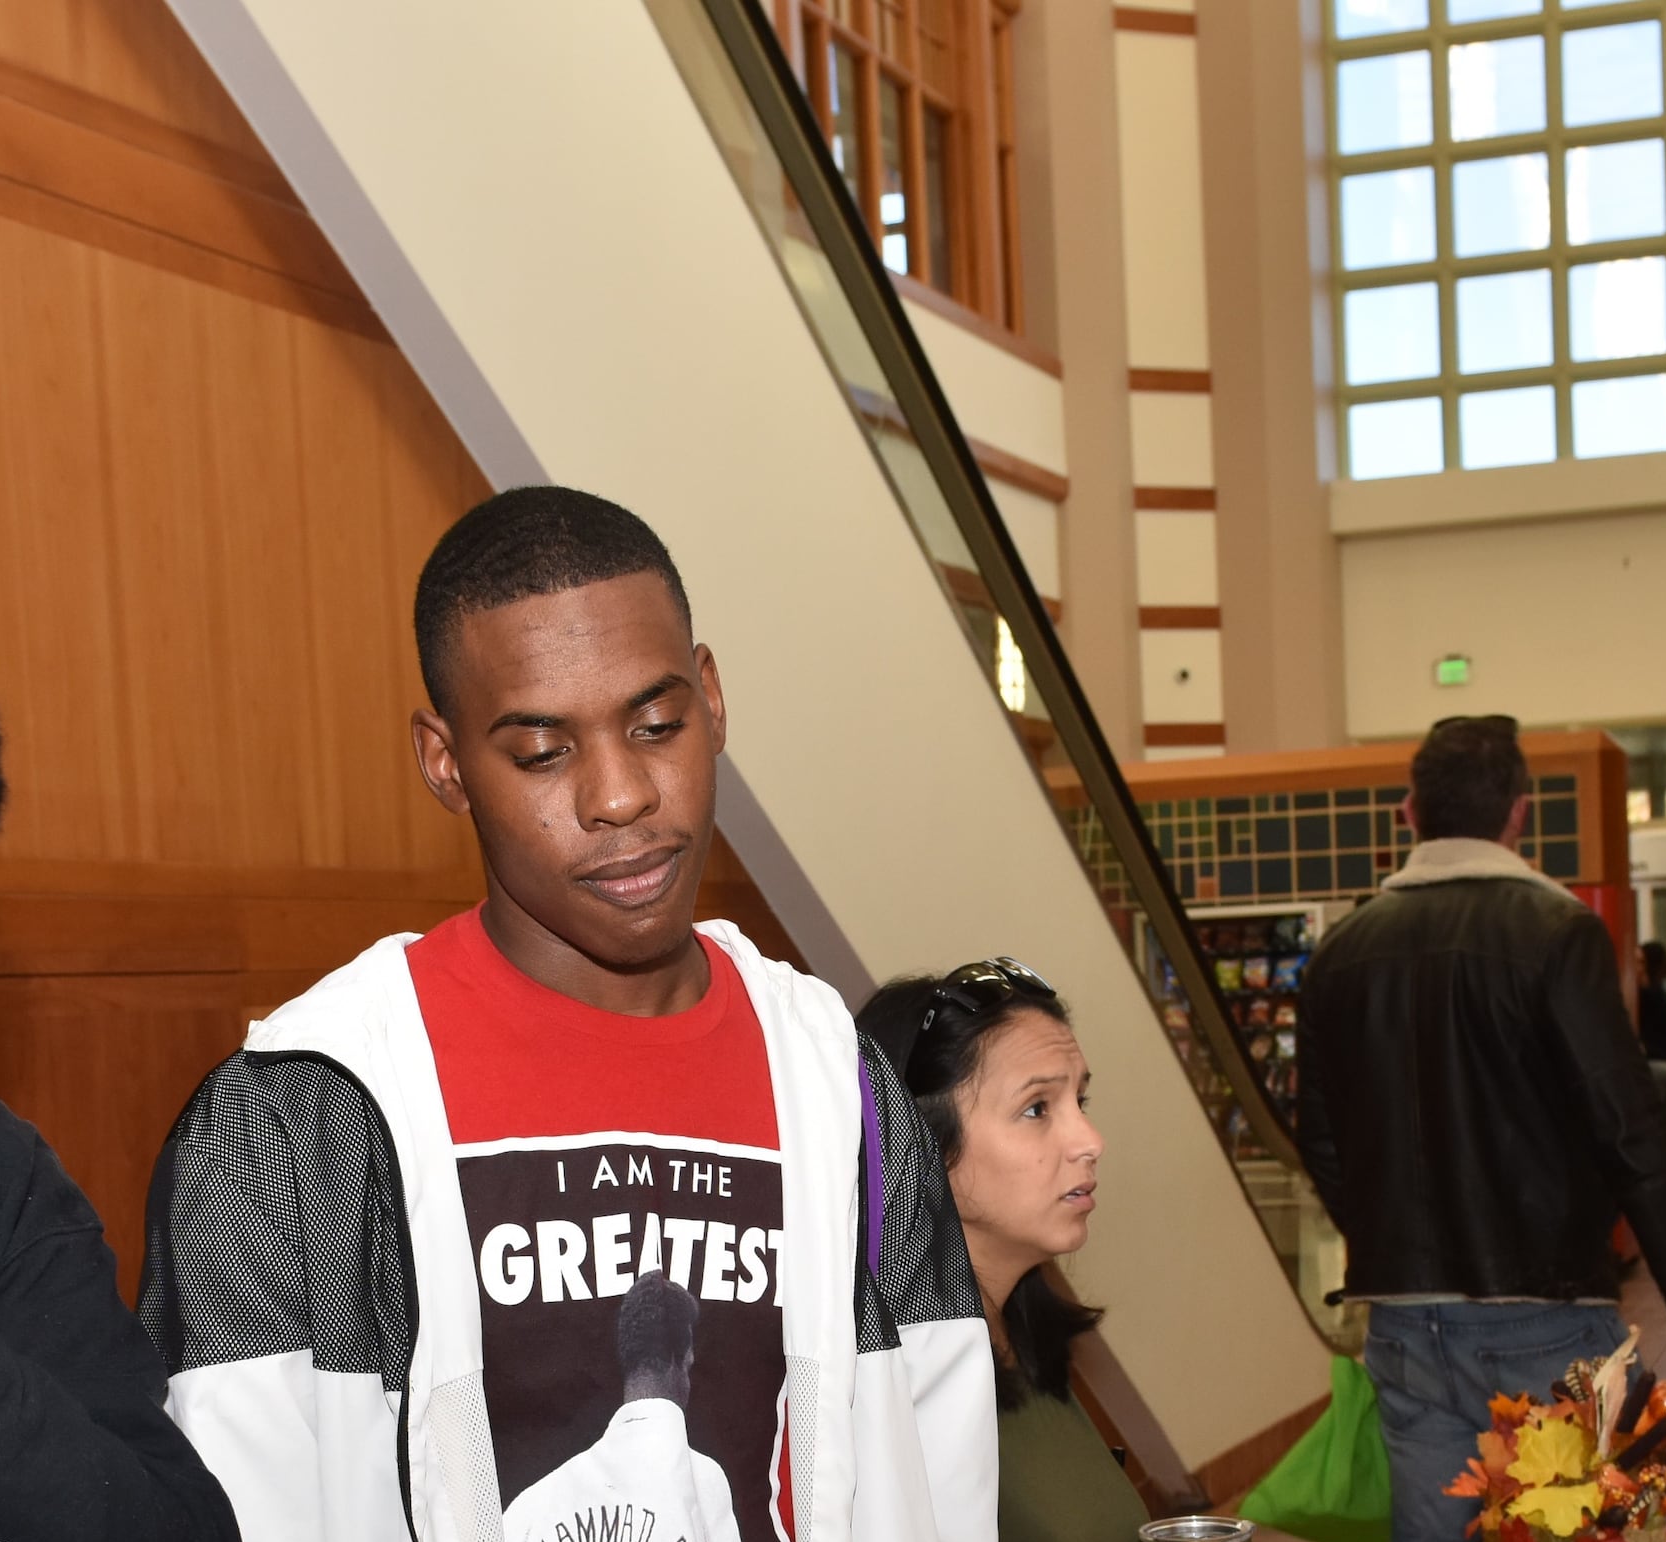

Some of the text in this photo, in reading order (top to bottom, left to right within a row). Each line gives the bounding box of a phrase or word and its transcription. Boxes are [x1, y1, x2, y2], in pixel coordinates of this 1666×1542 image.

[557, 1154, 732, 1198] I AM THE
